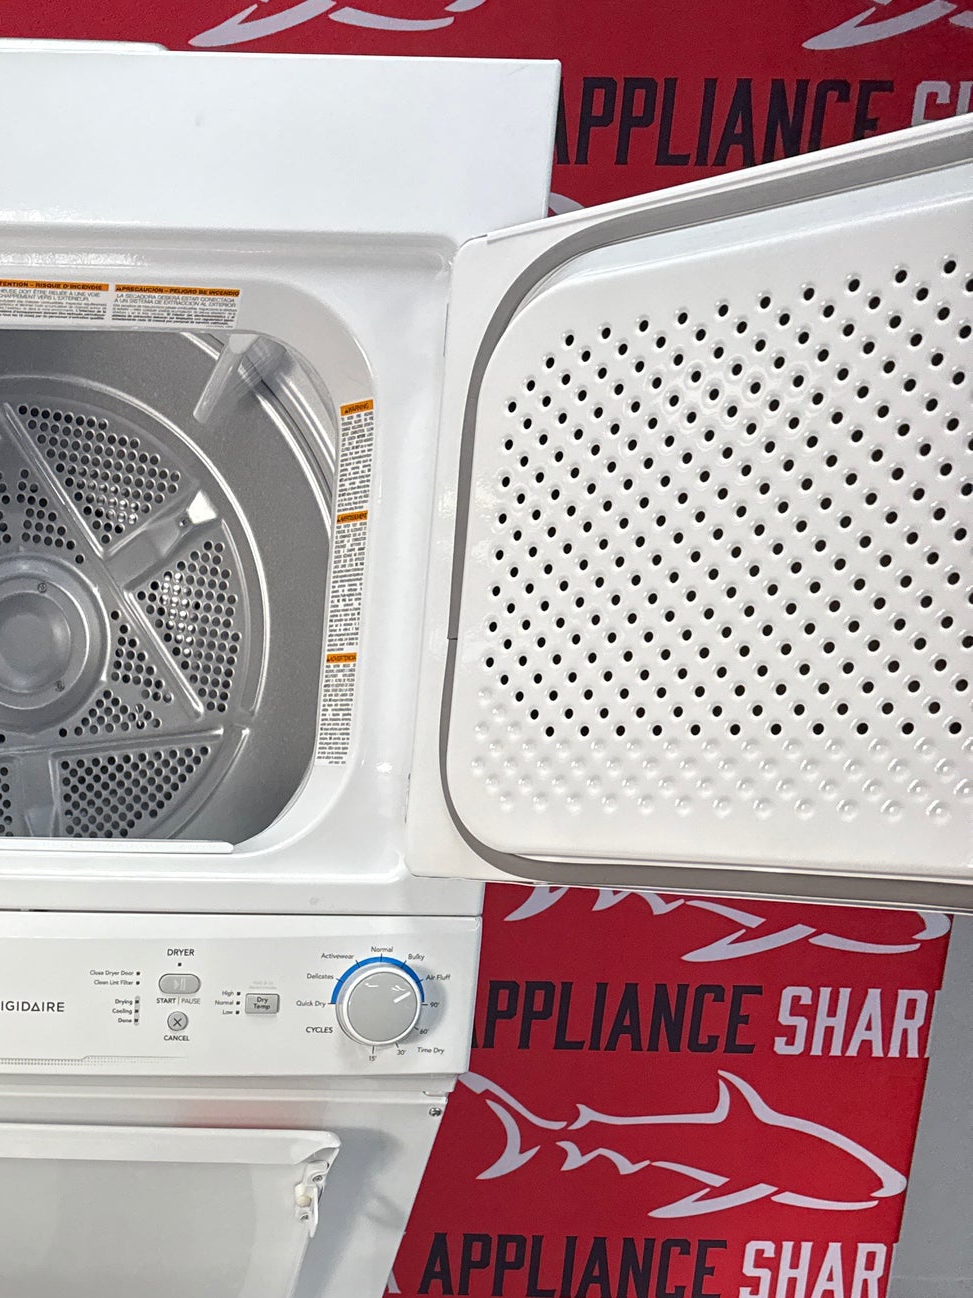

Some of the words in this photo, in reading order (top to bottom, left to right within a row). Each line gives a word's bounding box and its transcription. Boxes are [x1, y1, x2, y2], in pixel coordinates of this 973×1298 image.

[166, 948, 195, 956] DRYER
[407, 953, 425, 961] Bulky
[256, 996, 269, 1004] Dry
[315, 1000, 326, 1008] Dry
[472, 980, 764, 1054] PPLIANCE
[774, 986, 936, 1058] SHAR
[432, 1047, 445, 1055] Dry
